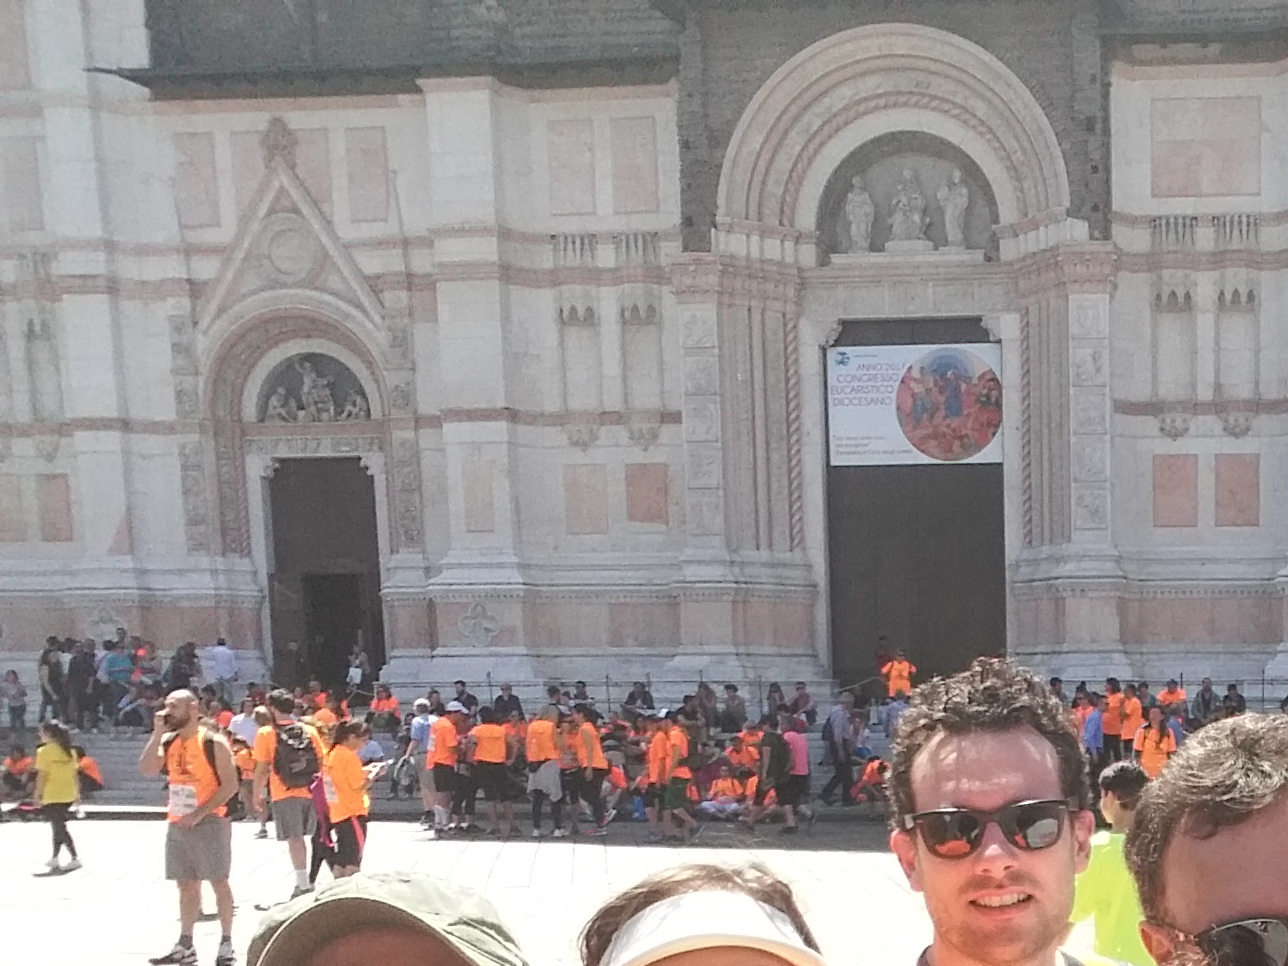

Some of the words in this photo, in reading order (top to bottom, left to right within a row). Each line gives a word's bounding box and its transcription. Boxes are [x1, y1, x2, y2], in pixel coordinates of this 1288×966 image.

[857, 363, 882, 372] ANNO
[836, 373, 900, 383] CONGRESSO
[830, 385, 894, 396] EUCARISTICO
[832, 396, 892, 407] DIOCESANO
